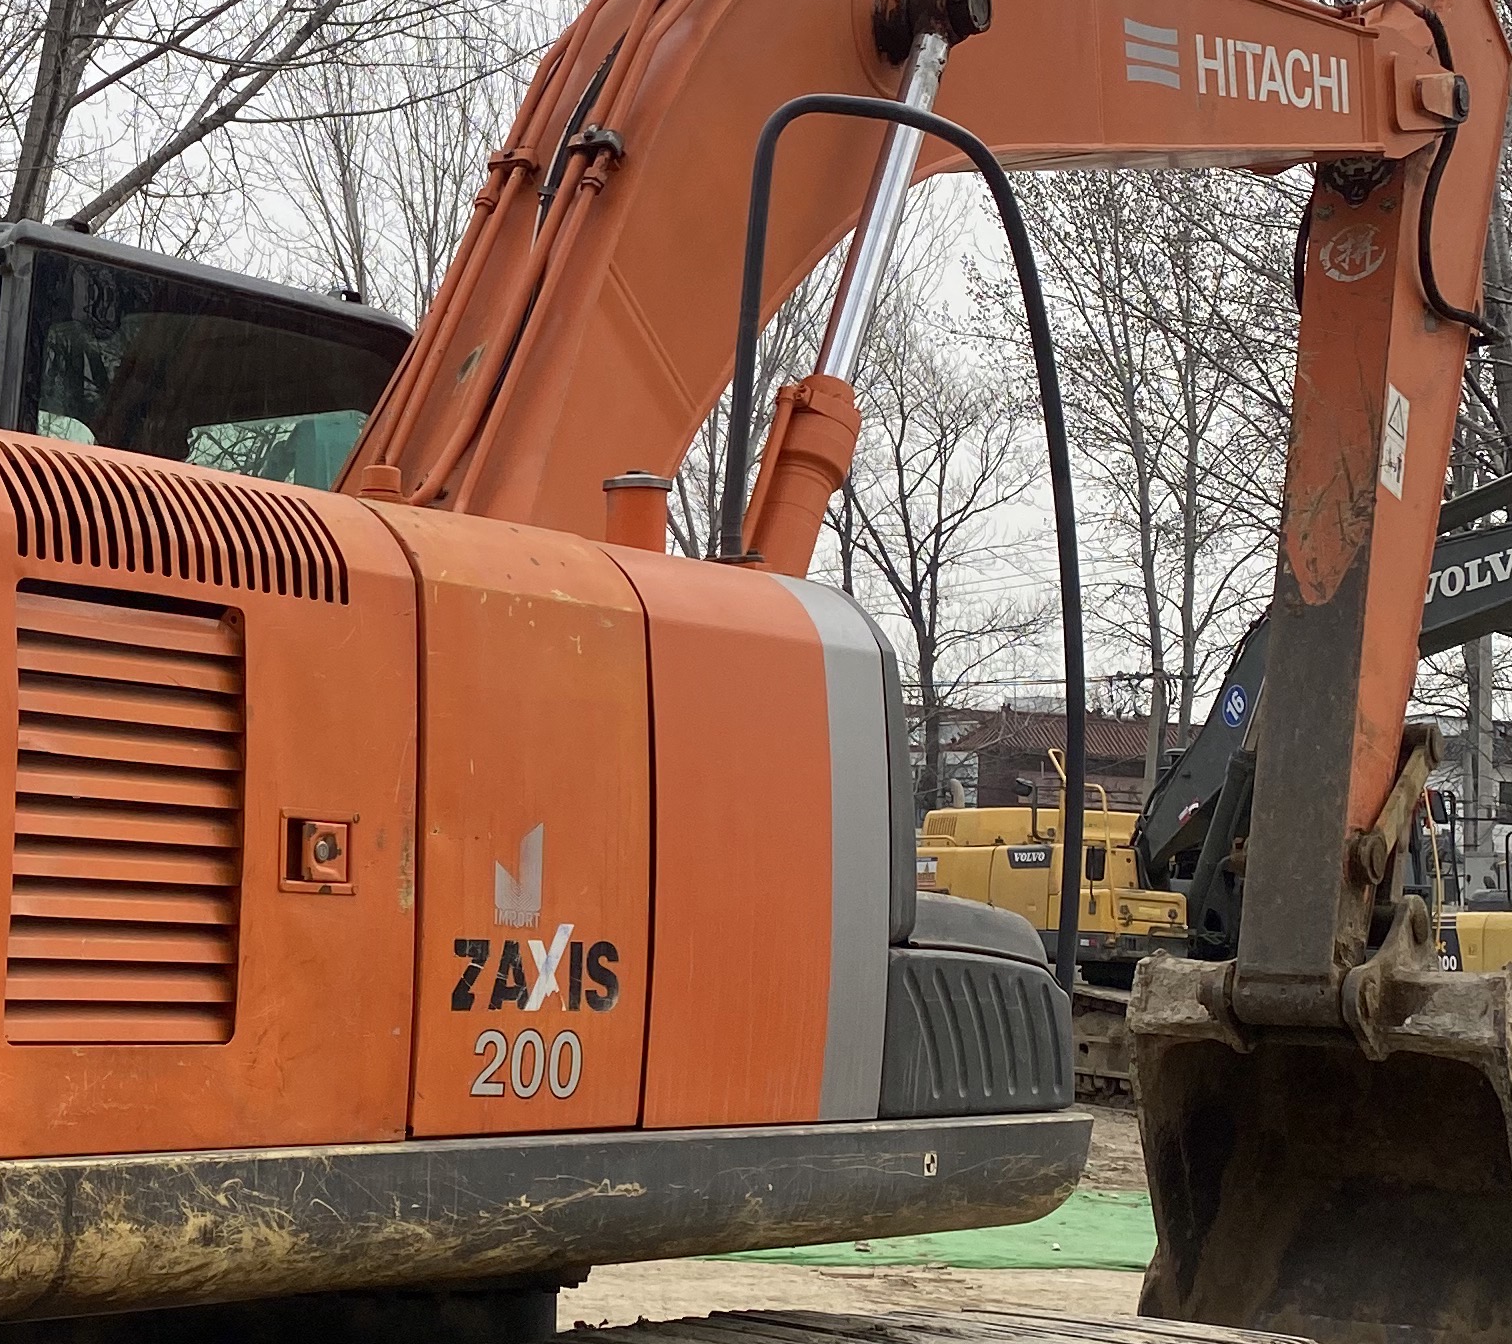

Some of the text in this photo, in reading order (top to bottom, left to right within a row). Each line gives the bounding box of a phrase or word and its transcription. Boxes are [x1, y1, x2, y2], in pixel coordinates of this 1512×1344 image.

[1195, 34, 1350, 114] HITACHI
[1226, 690, 1245, 721] 16
[1014, 851, 1046, 862] VOLVO
[494, 908, 541, 929] IMPORT
[451, 923, 620, 1013] ZAXIS
[469, 1027, 583, 1099] 200
